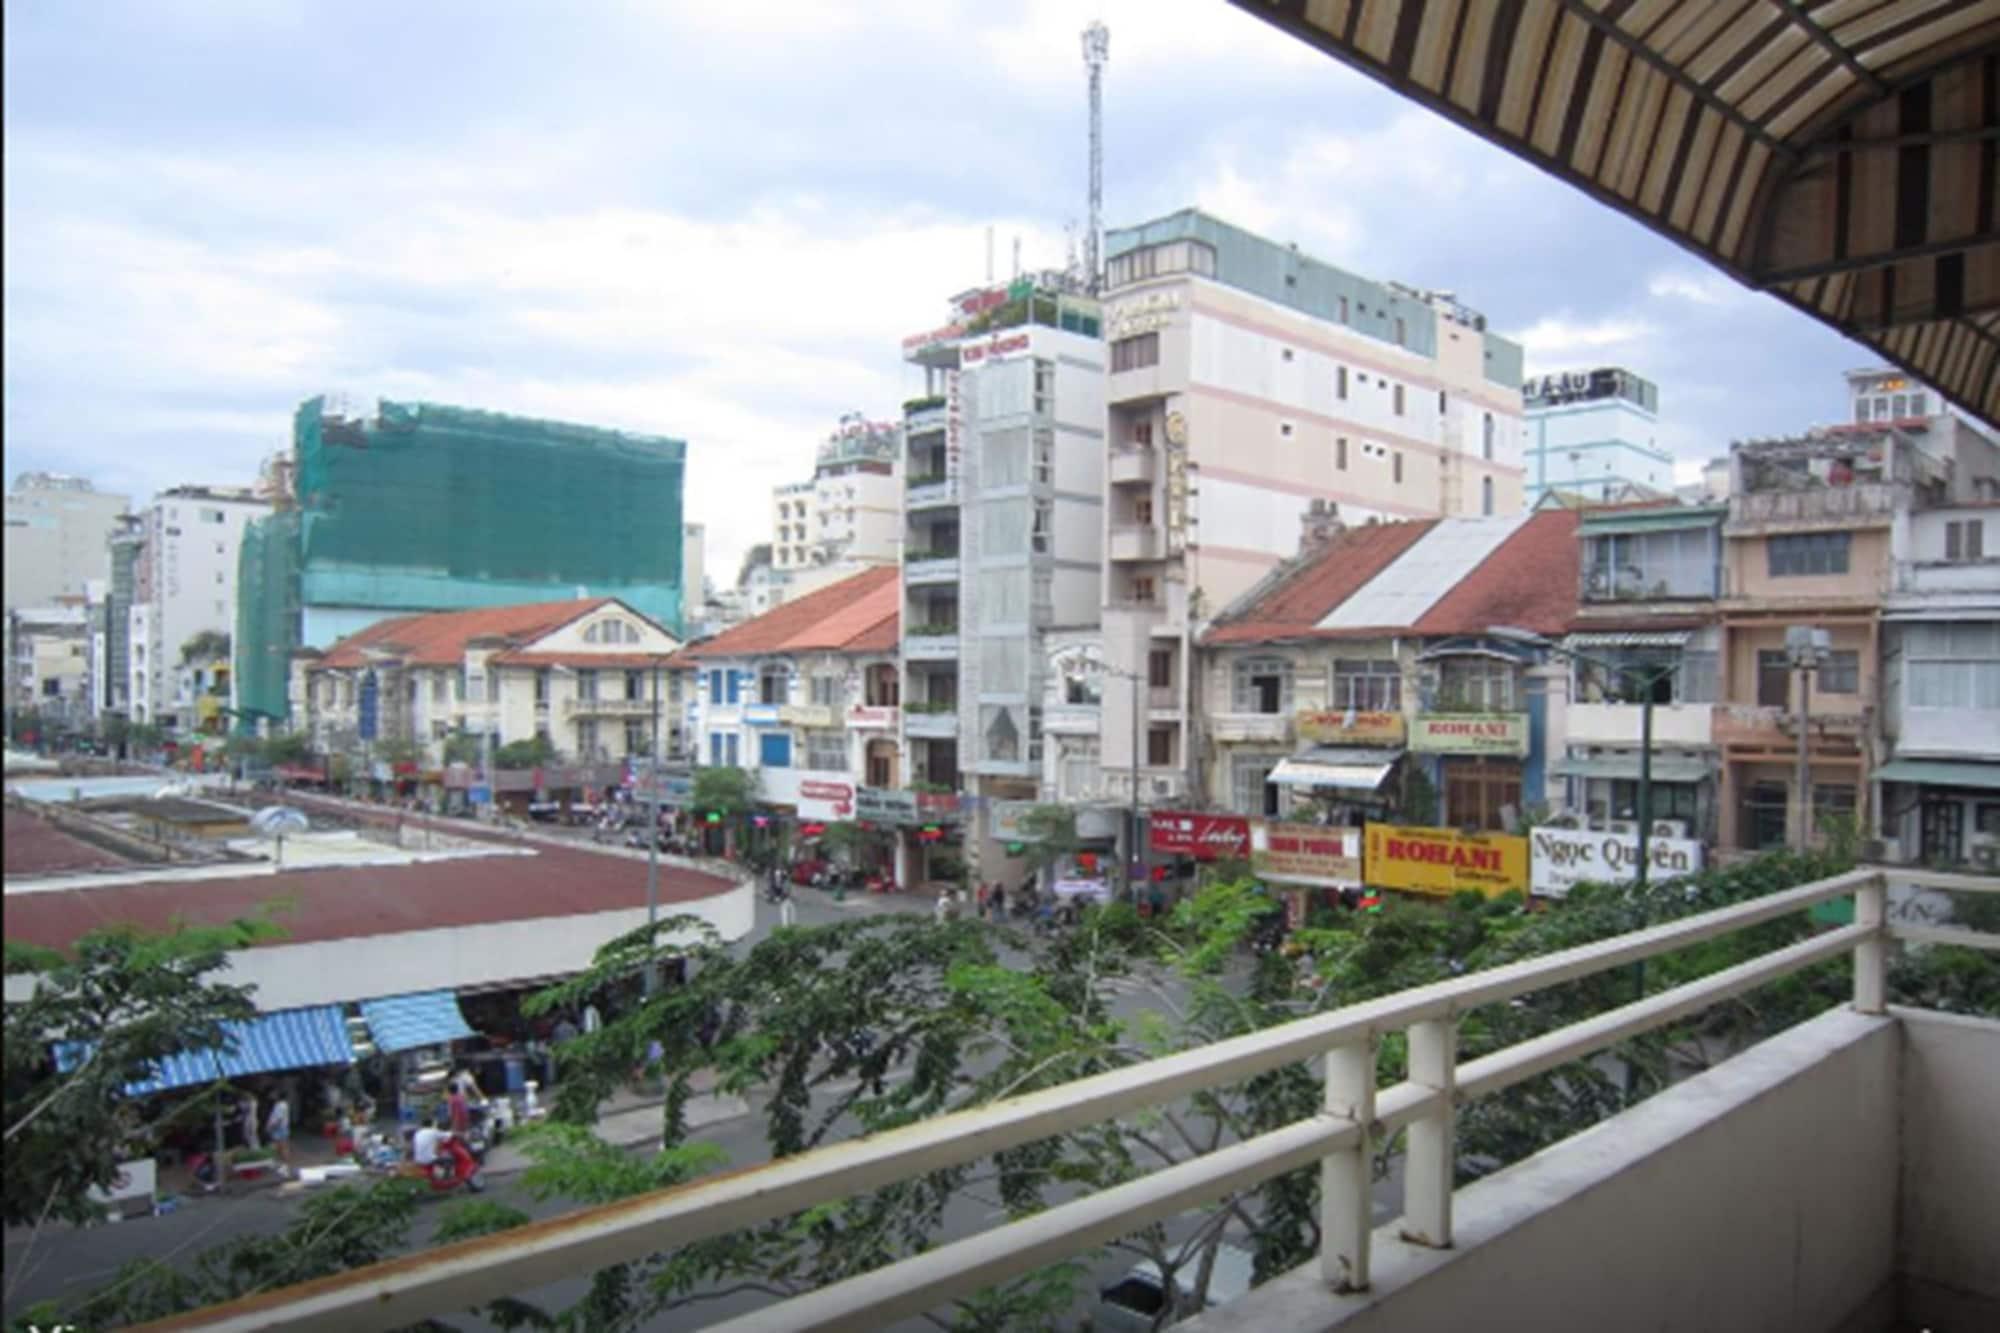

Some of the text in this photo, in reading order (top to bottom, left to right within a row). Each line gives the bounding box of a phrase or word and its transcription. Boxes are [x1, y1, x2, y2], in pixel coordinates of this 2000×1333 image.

[1428, 721, 1508, 738] ROHANI
[1386, 837, 1504, 871] ROHANI
[1534, 832, 1689, 871] Ngọc Quên
